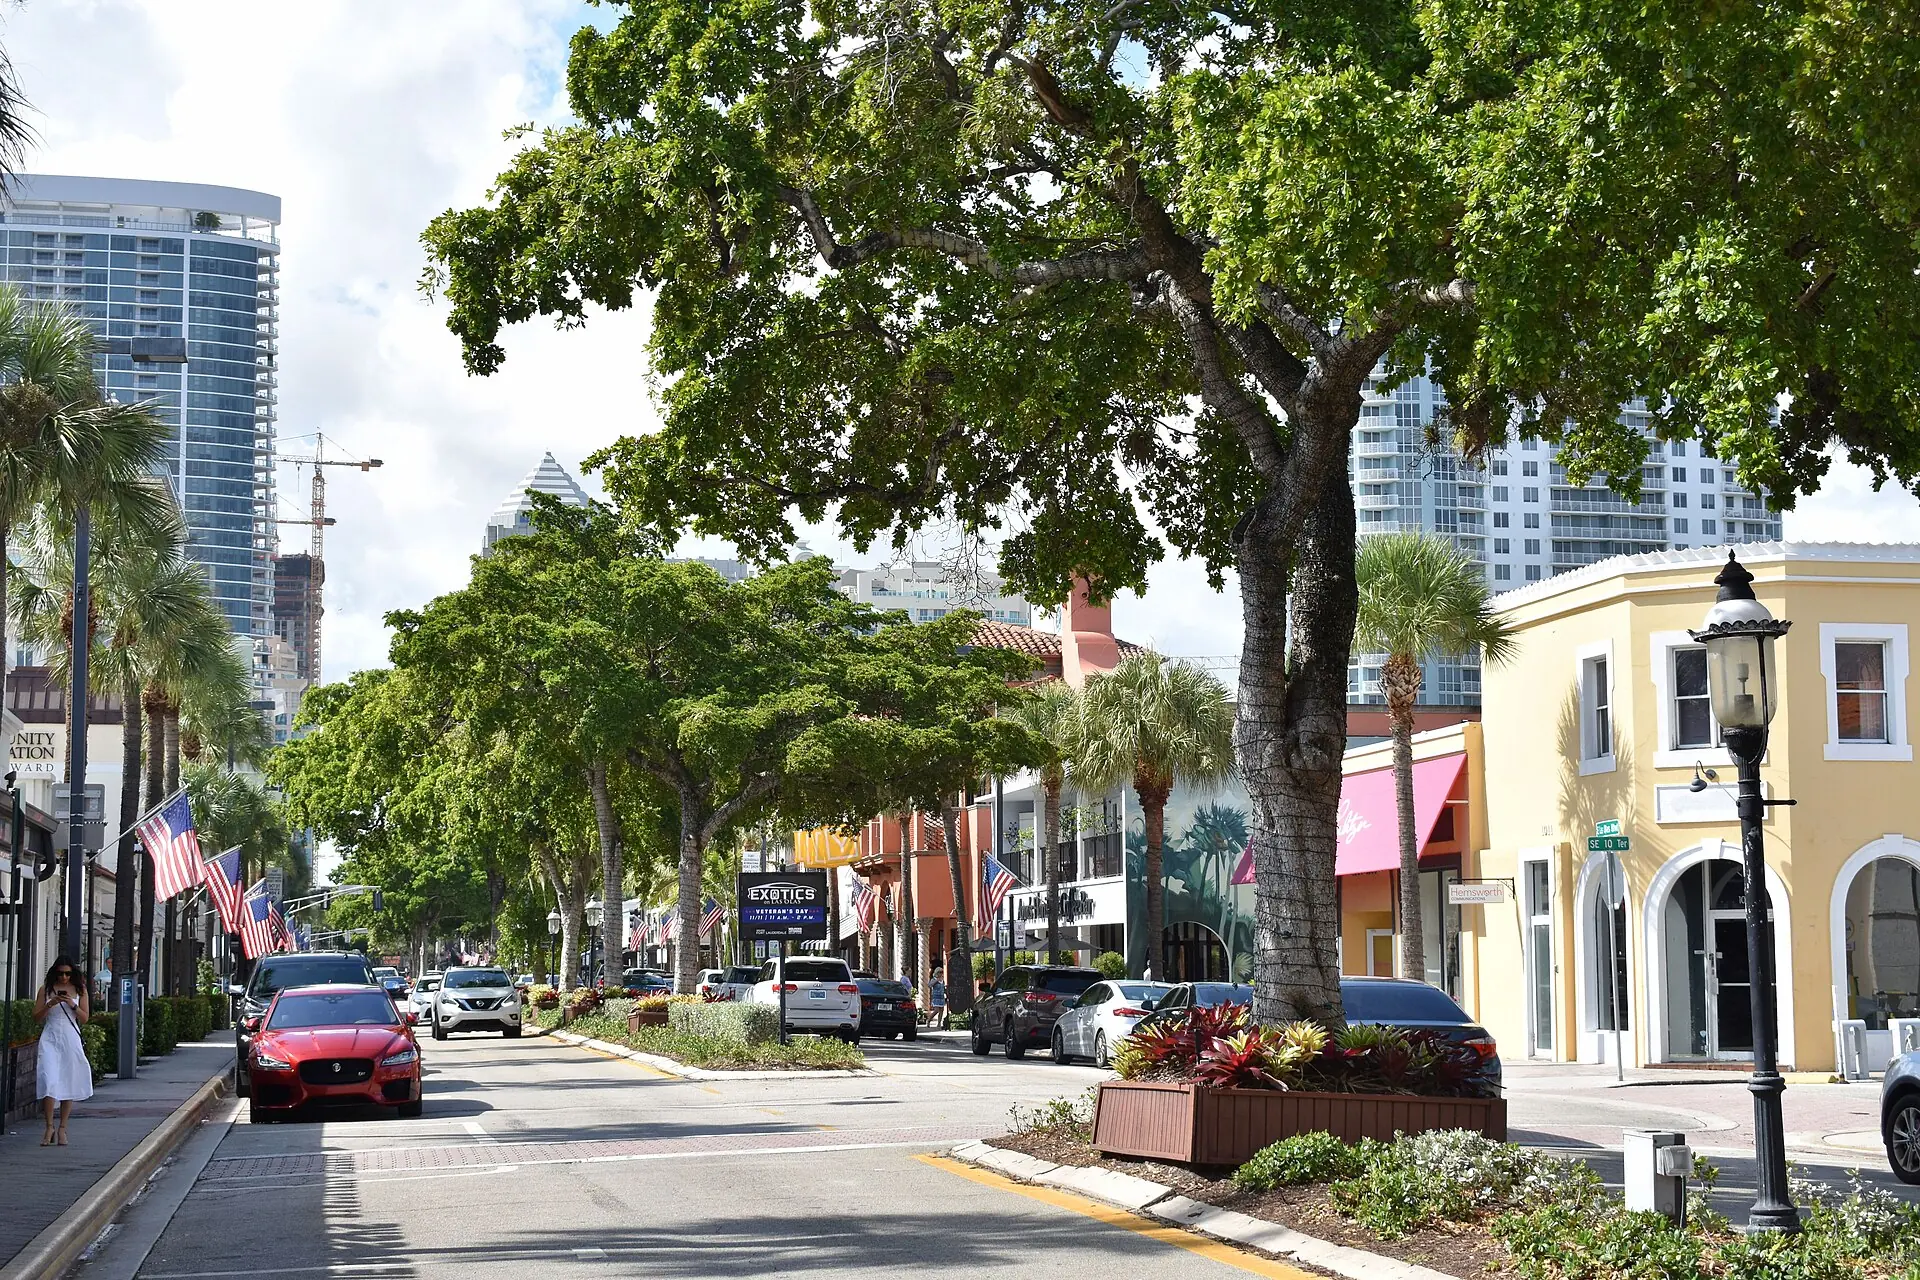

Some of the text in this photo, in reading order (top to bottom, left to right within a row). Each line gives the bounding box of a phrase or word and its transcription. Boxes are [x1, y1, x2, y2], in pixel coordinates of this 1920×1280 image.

[11, 763, 54, 772] WARD
[1590, 839, 1628, 849] SE 10 Ter
[750, 888, 815, 900] EXOTICS
[1451, 887, 1503, 897] Hemsworth
